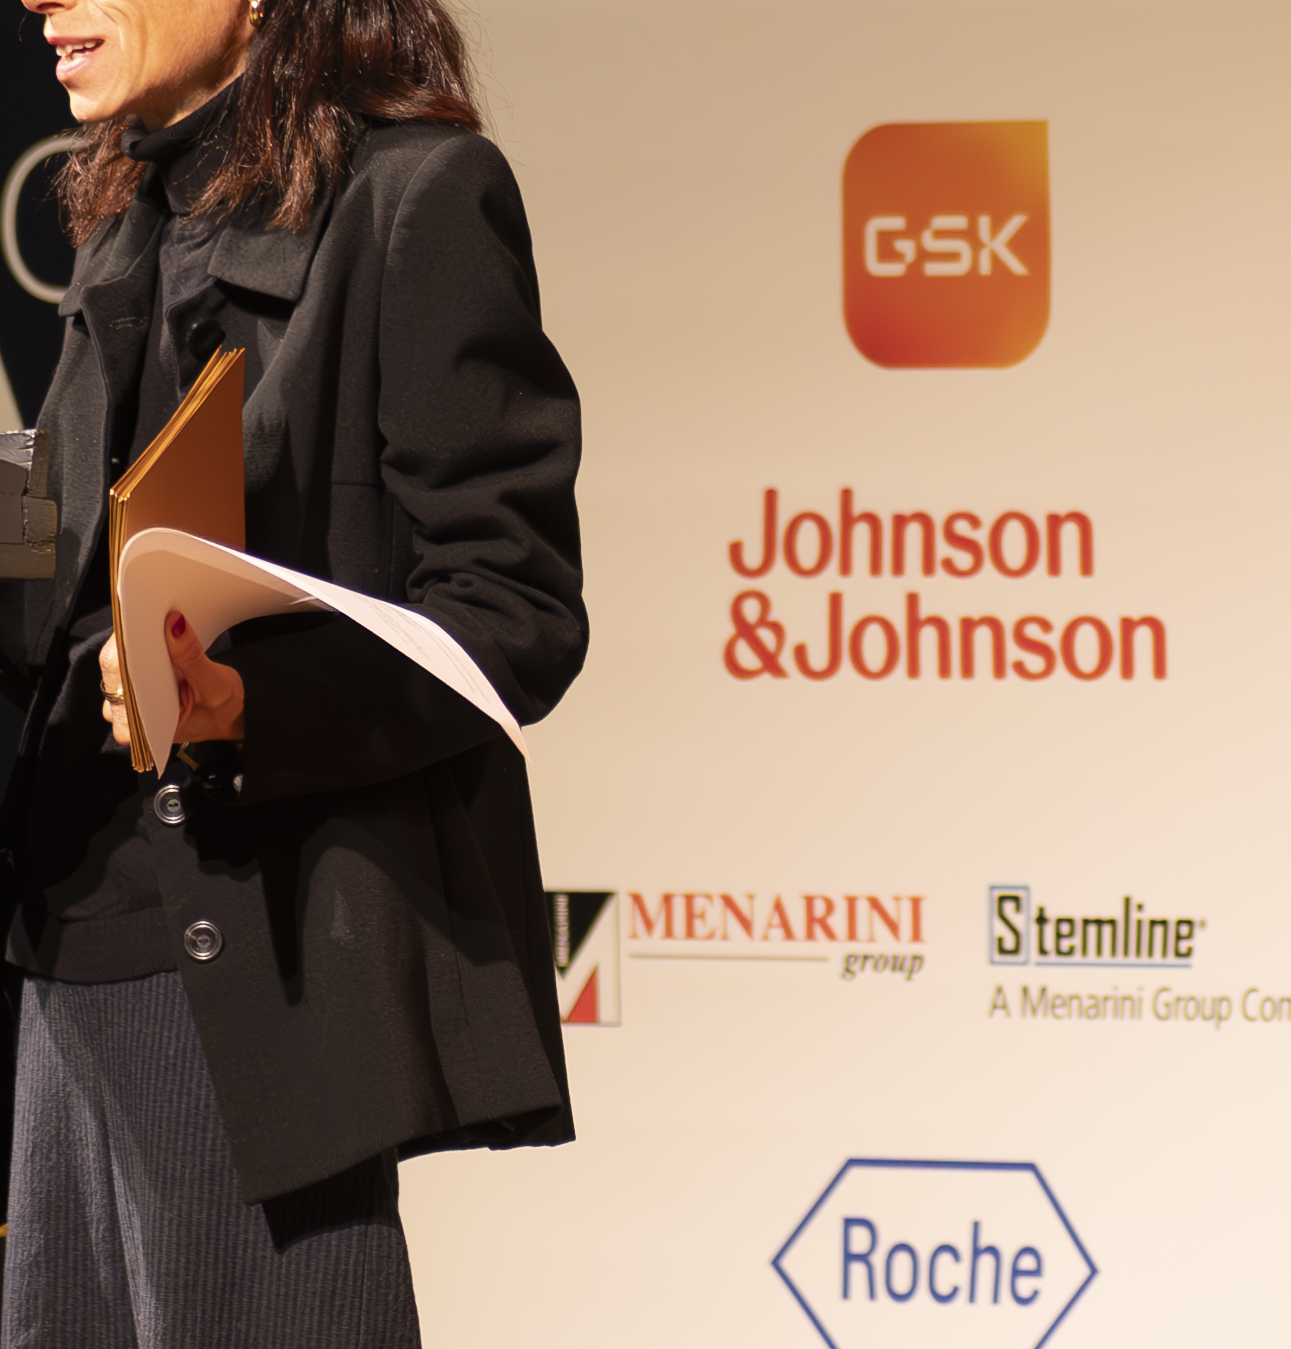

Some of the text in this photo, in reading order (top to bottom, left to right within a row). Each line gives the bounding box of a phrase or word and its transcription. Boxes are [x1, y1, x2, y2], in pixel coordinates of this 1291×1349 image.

[863, 214, 1031, 278] GSK
[728, 487, 1095, 579] Johnson
[723, 589, 1169, 681] &Johnson
[629, 892, 928, 945] MENARINI
[991, 890, 1197, 964] Stemline
[841, 949, 926, 980] group
[989, 985, 1011, 1020] A
[1021, 987, 1143, 1024] Menarini
[1152, 987, 1233, 1030] Group
[841, 1216, 1045, 1306] Roche
